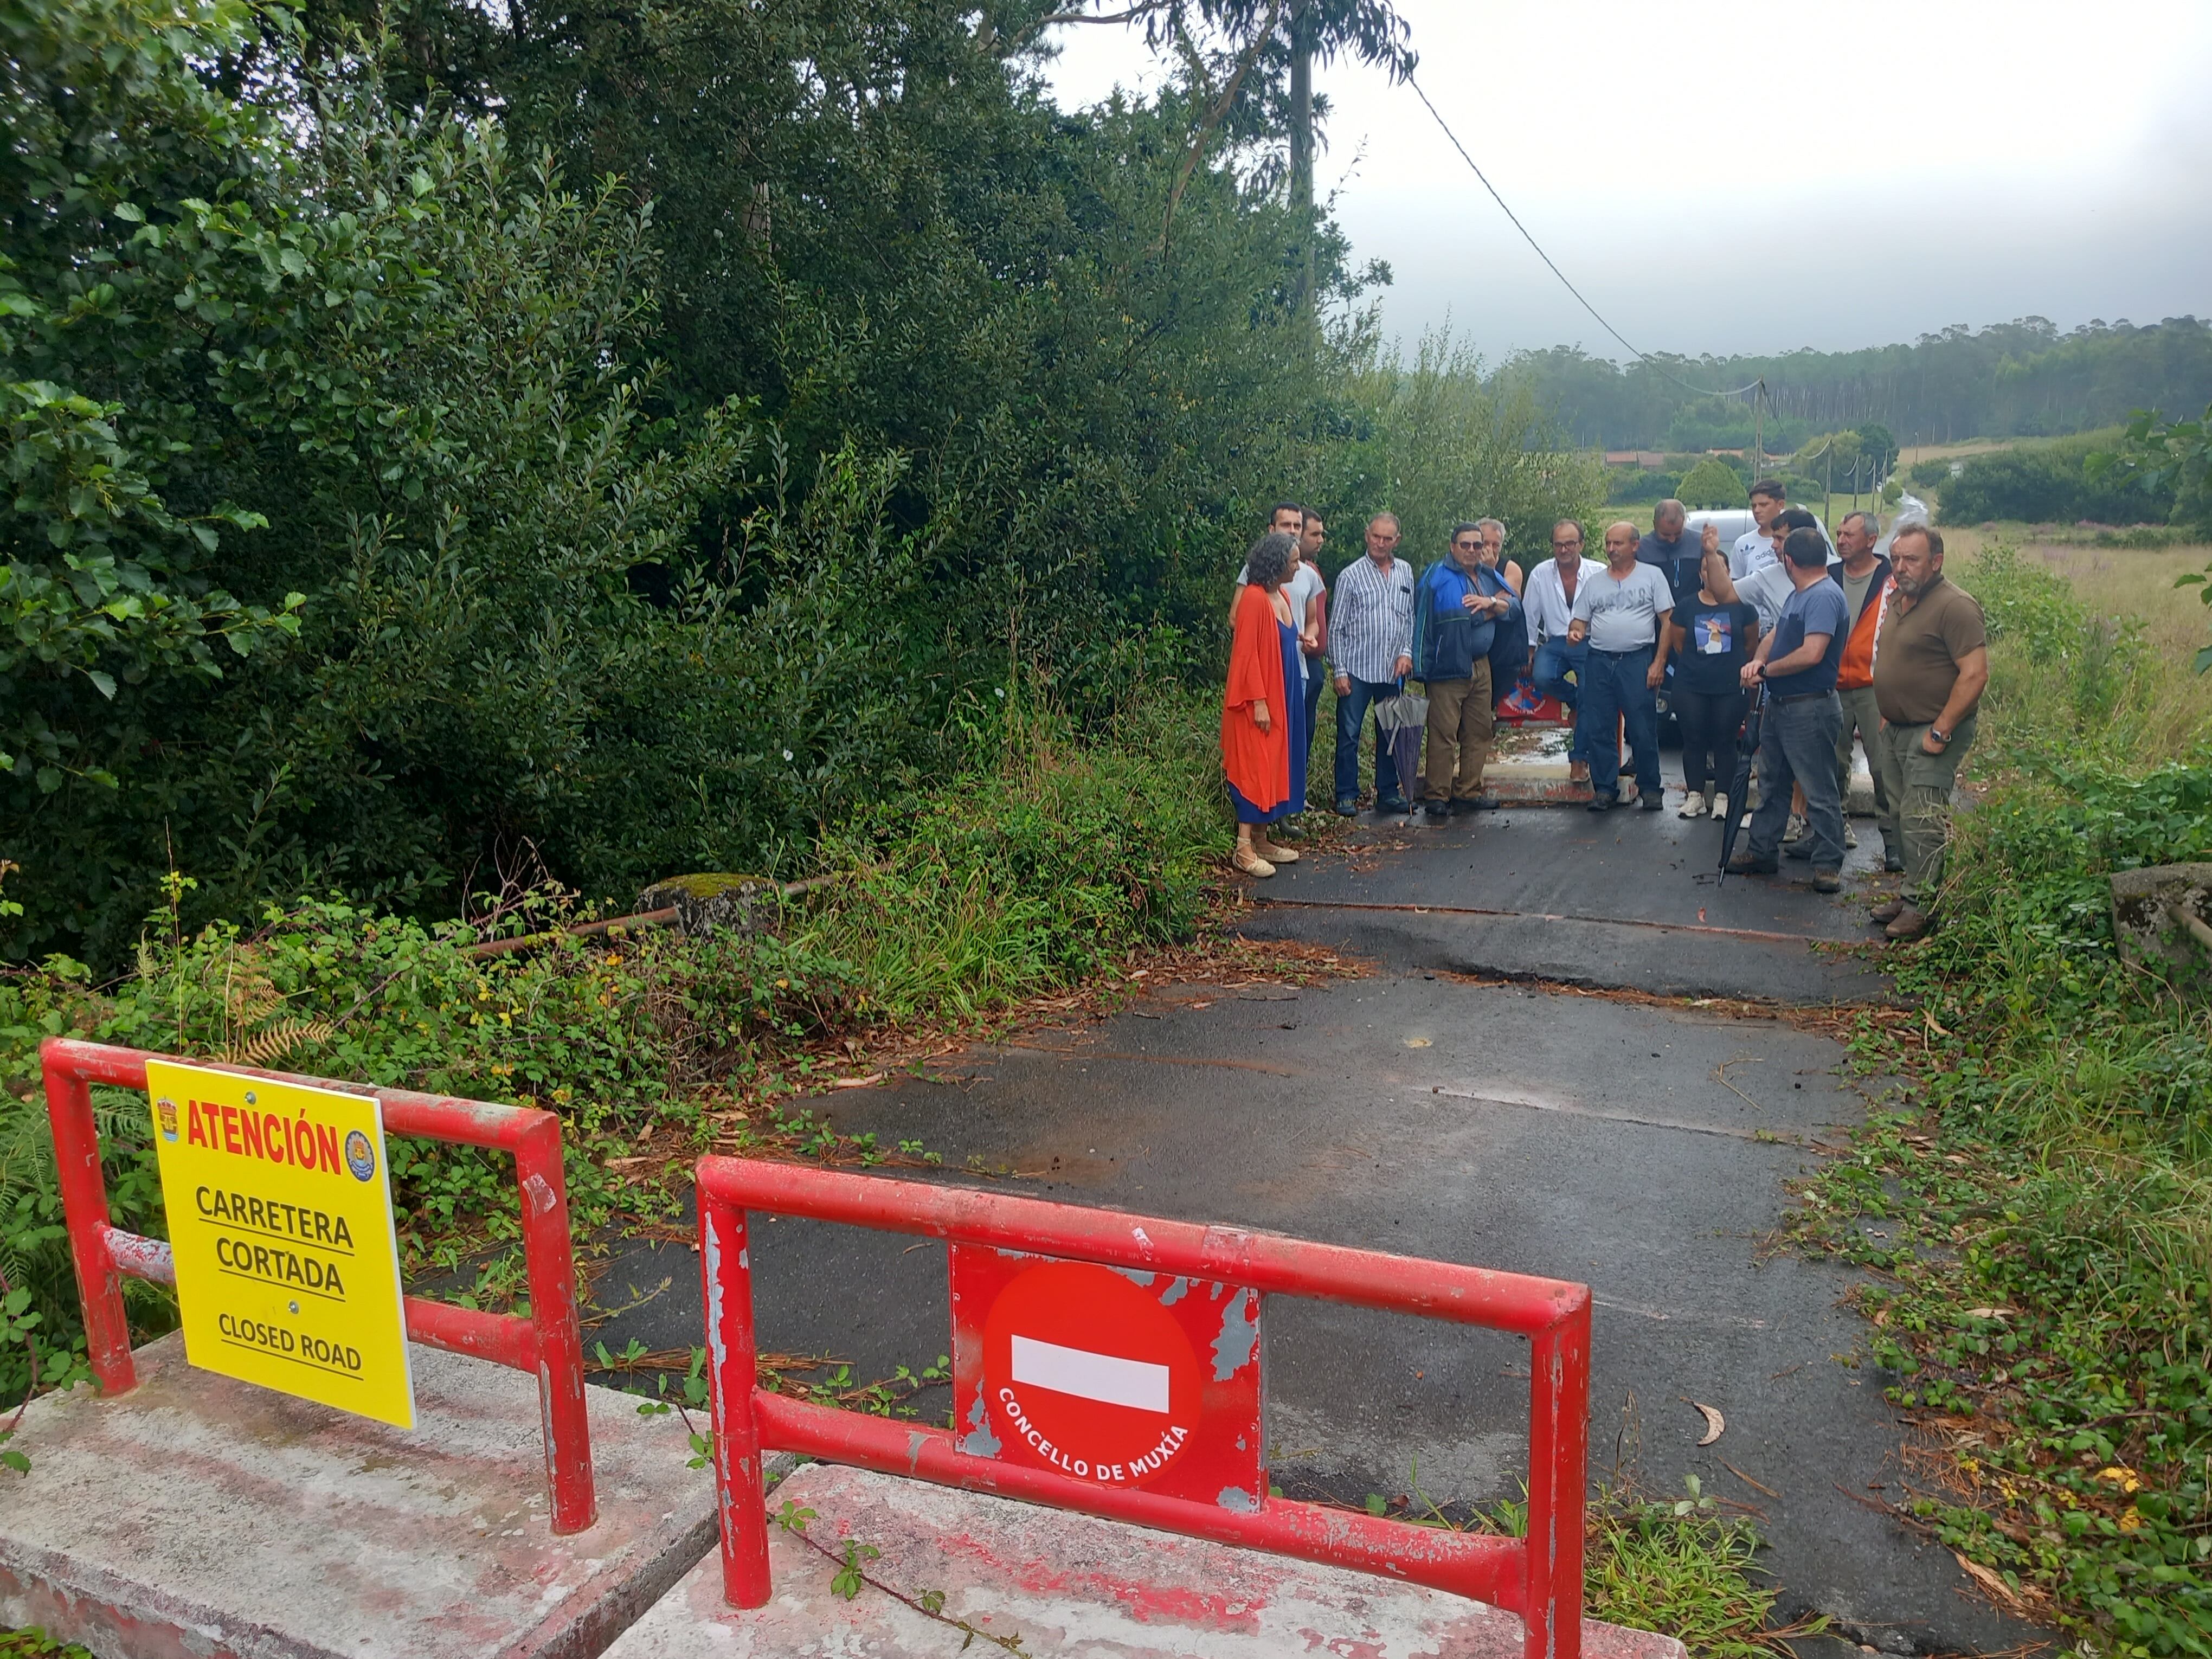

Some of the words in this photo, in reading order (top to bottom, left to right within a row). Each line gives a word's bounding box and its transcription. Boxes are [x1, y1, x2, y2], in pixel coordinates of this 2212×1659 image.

[189, 1099, 341, 1175] ATENCIÓN
[196, 1186, 353, 1249] CARRETERA
[216, 1237, 344, 1295] CORTADA
[219, 1313, 294, 1352] CLOSED
[301, 1335, 362, 1371] ROAD
[999, 1387, 1088, 1476] CONCELLO
[1096, 1464, 1126, 1481] DE
[1128, 1426, 1188, 1477] MUXÍA
